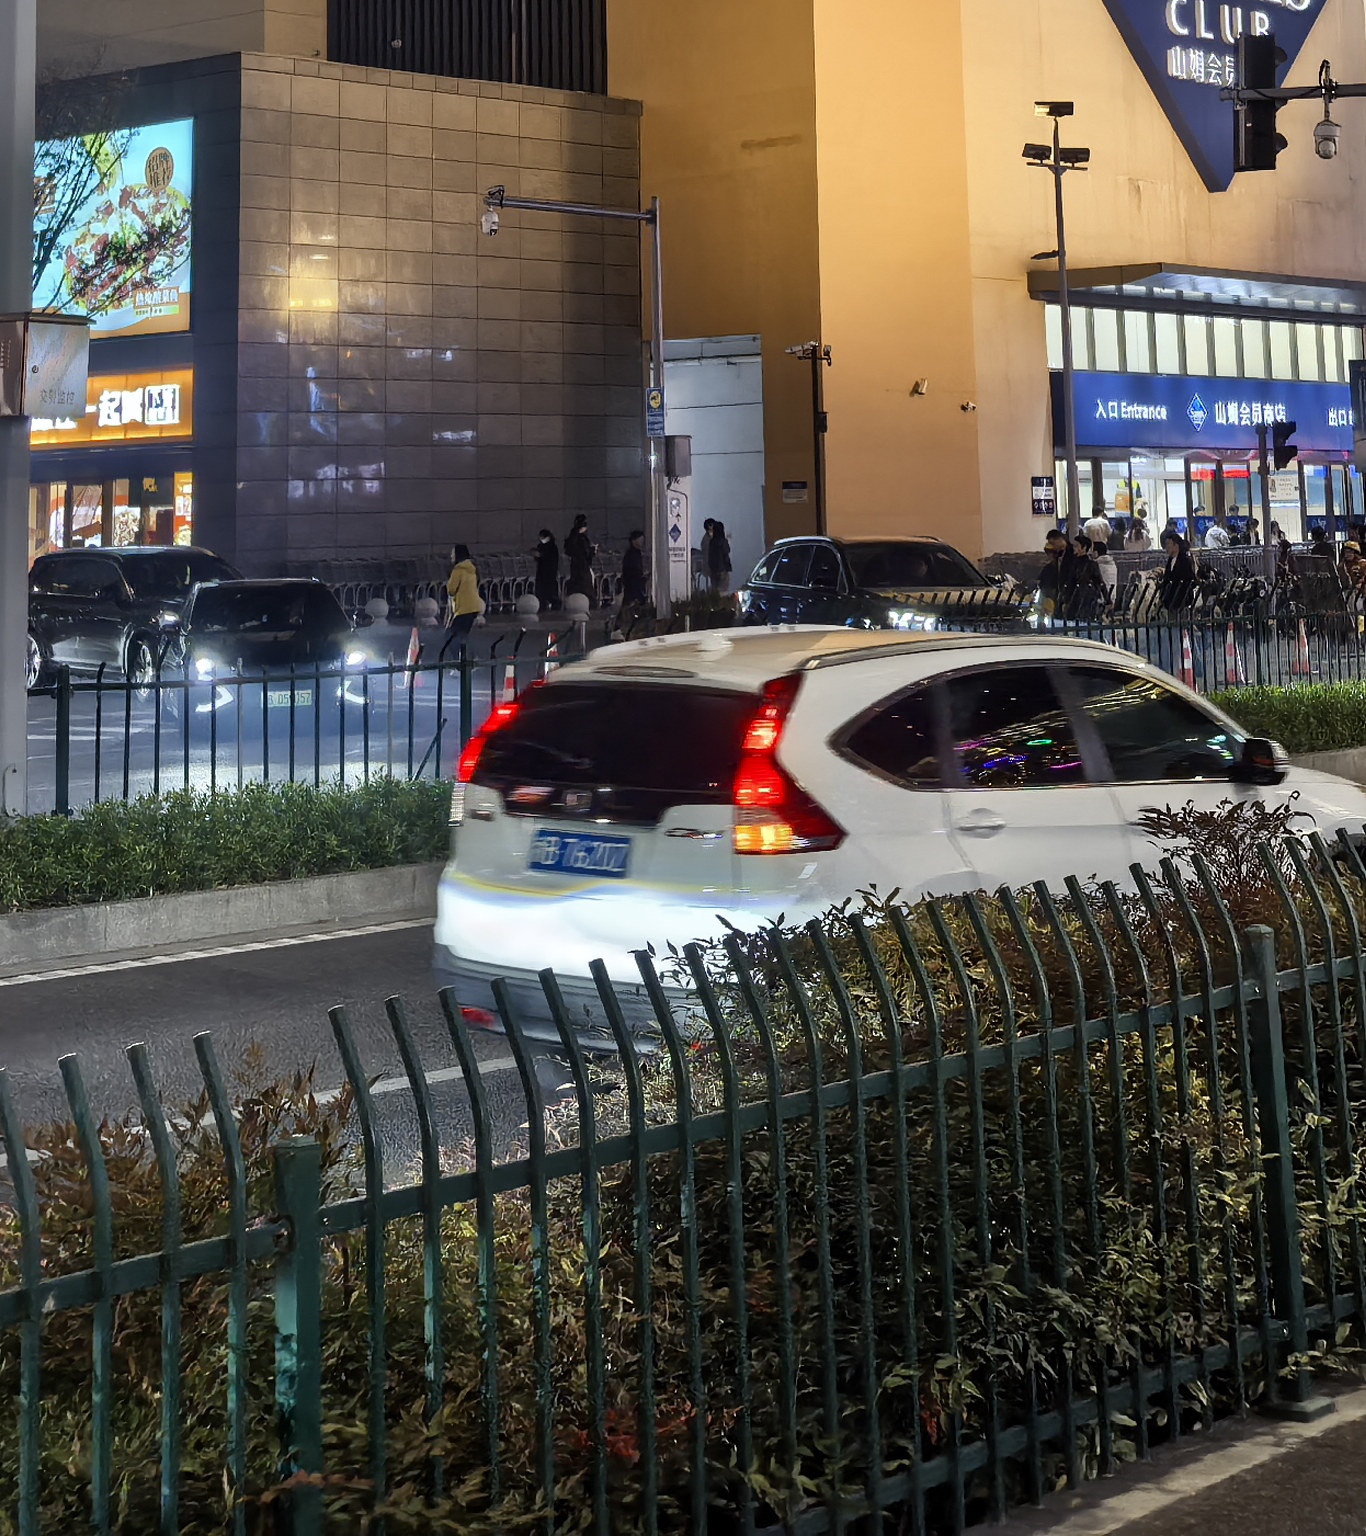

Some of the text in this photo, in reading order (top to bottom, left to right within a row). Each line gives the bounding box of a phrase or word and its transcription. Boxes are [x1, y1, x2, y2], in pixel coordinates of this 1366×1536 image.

[1167, 44, 1239, 87] 山姆会员
[1095, 399, 1118, 419] 入口
[1121, 402, 1167, 421] Entrance
[1215, 400, 1286, 427] 山姆会员商店
[1328, 406, 1348, 427] 出口
